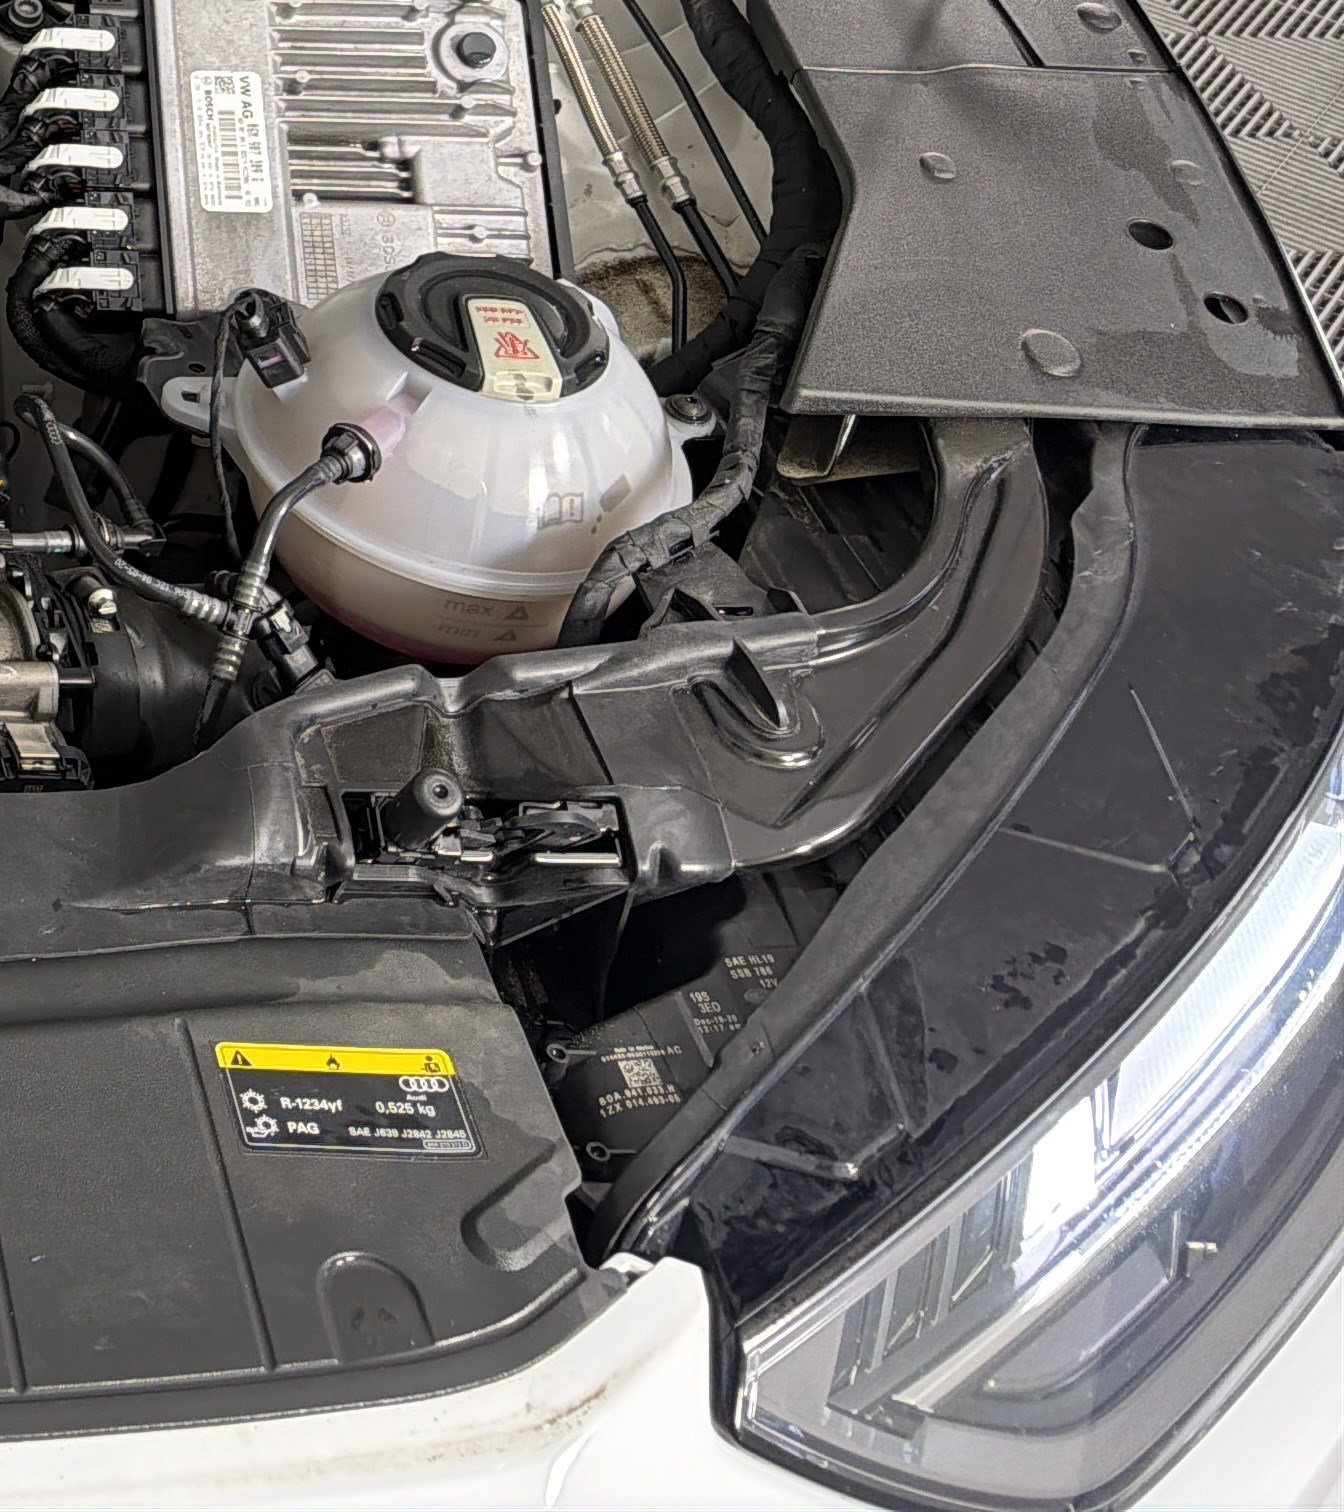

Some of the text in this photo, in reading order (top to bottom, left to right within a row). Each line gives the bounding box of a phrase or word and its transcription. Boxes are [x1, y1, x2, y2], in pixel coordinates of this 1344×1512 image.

[239, 75, 252, 97] VW
[241, 100, 254, 120] AG
[443, 599, 495, 617] max
[438, 623, 480, 637] min
[724, 955, 747, 968] SAE
[279, 1096, 343, 1114] R-1234yf
[375, 1100, 436, 1118] 0,525 kg
[287, 1121, 320, 1136] PAG
[348, 1125, 371, 1138] SAE
